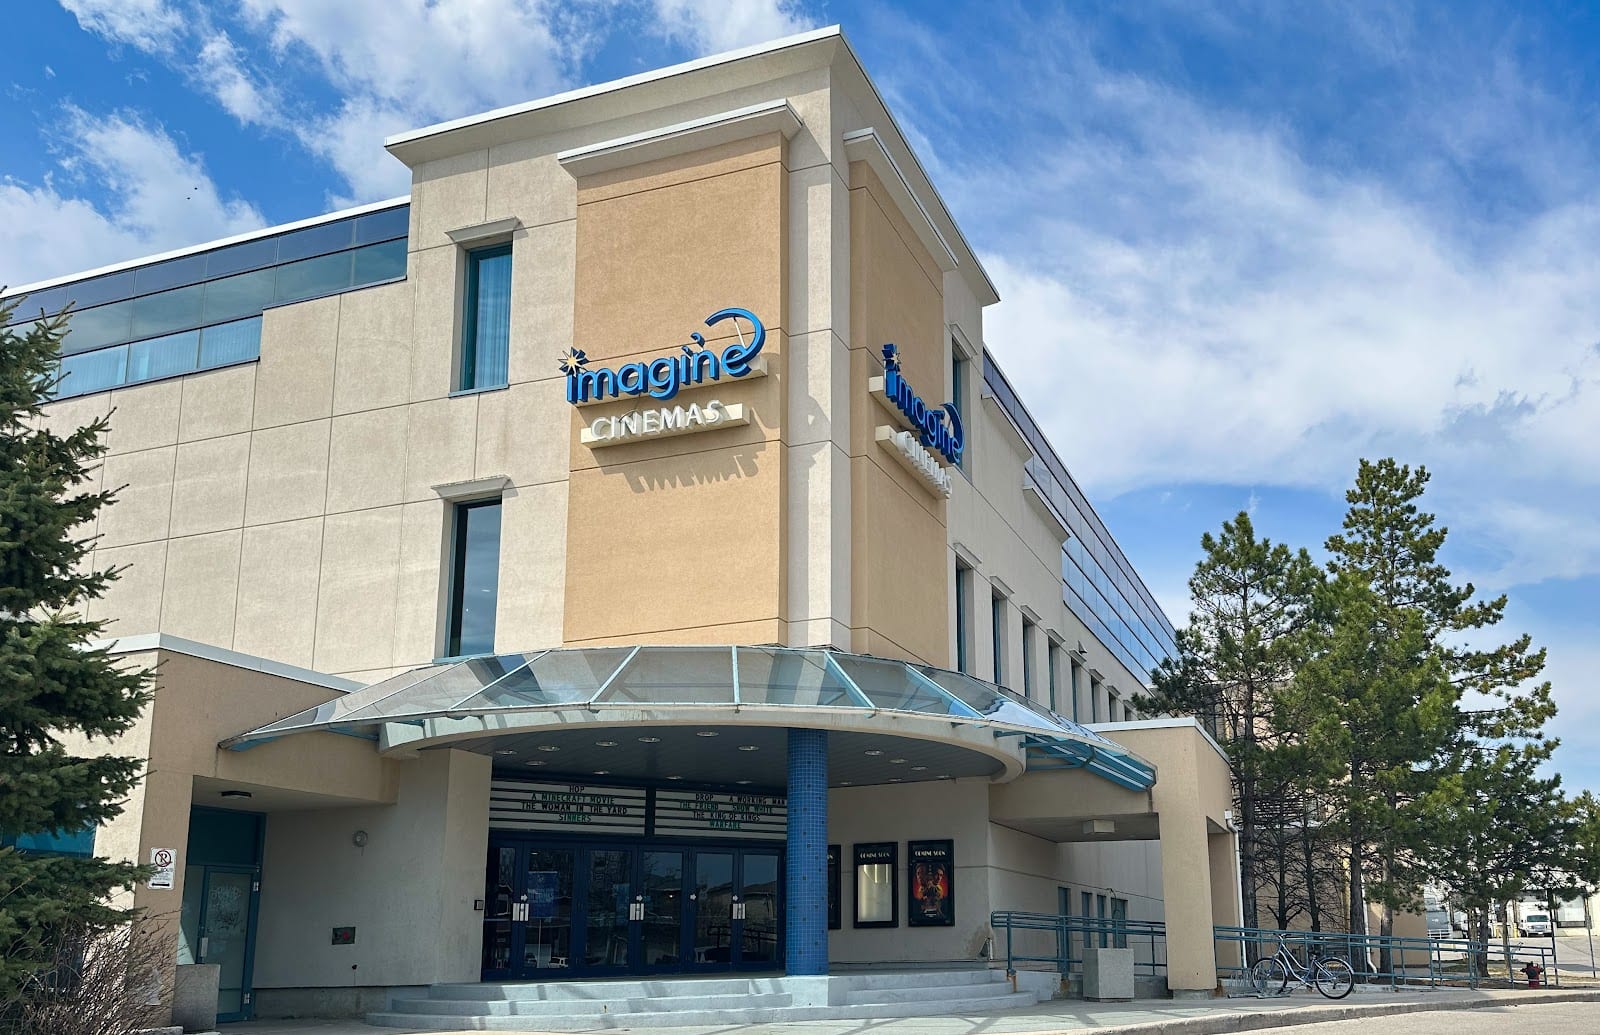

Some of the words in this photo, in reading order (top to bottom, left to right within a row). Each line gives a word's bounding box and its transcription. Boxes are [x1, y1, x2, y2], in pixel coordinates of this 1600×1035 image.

[557, 307, 766, 404] imagine
[882, 343, 965, 464] imagine
[591, 400, 728, 441] CINEMAS
[569, 785, 585, 793] HOP
[541, 793, 585, 803] MINECRAFT
[590, 796, 615, 805] MOVIE
[695, 793, 714, 801] DROP
[737, 796, 767, 805] WORKING
[772, 798, 785, 806] MAN
[522, 802, 535, 810] THE
[541, 803, 571, 812] WOMAN
[576, 804, 584, 812] IN
[590, 805, 604, 813] THE
[607, 806, 628, 815] YARD
[680, 801, 690, 809] THE
[695, 802, 719, 811] FRIEND
[732, 804, 750, 813] SNOW
[753, 806, 773, 814] WHITE
[558, 813, 592, 823] SINNERS
[692, 810, 705, 818] THE
[710, 811, 727, 820] KING
[741, 813, 761, 822] KINGS
[709, 820, 741, 829] WARFARE
